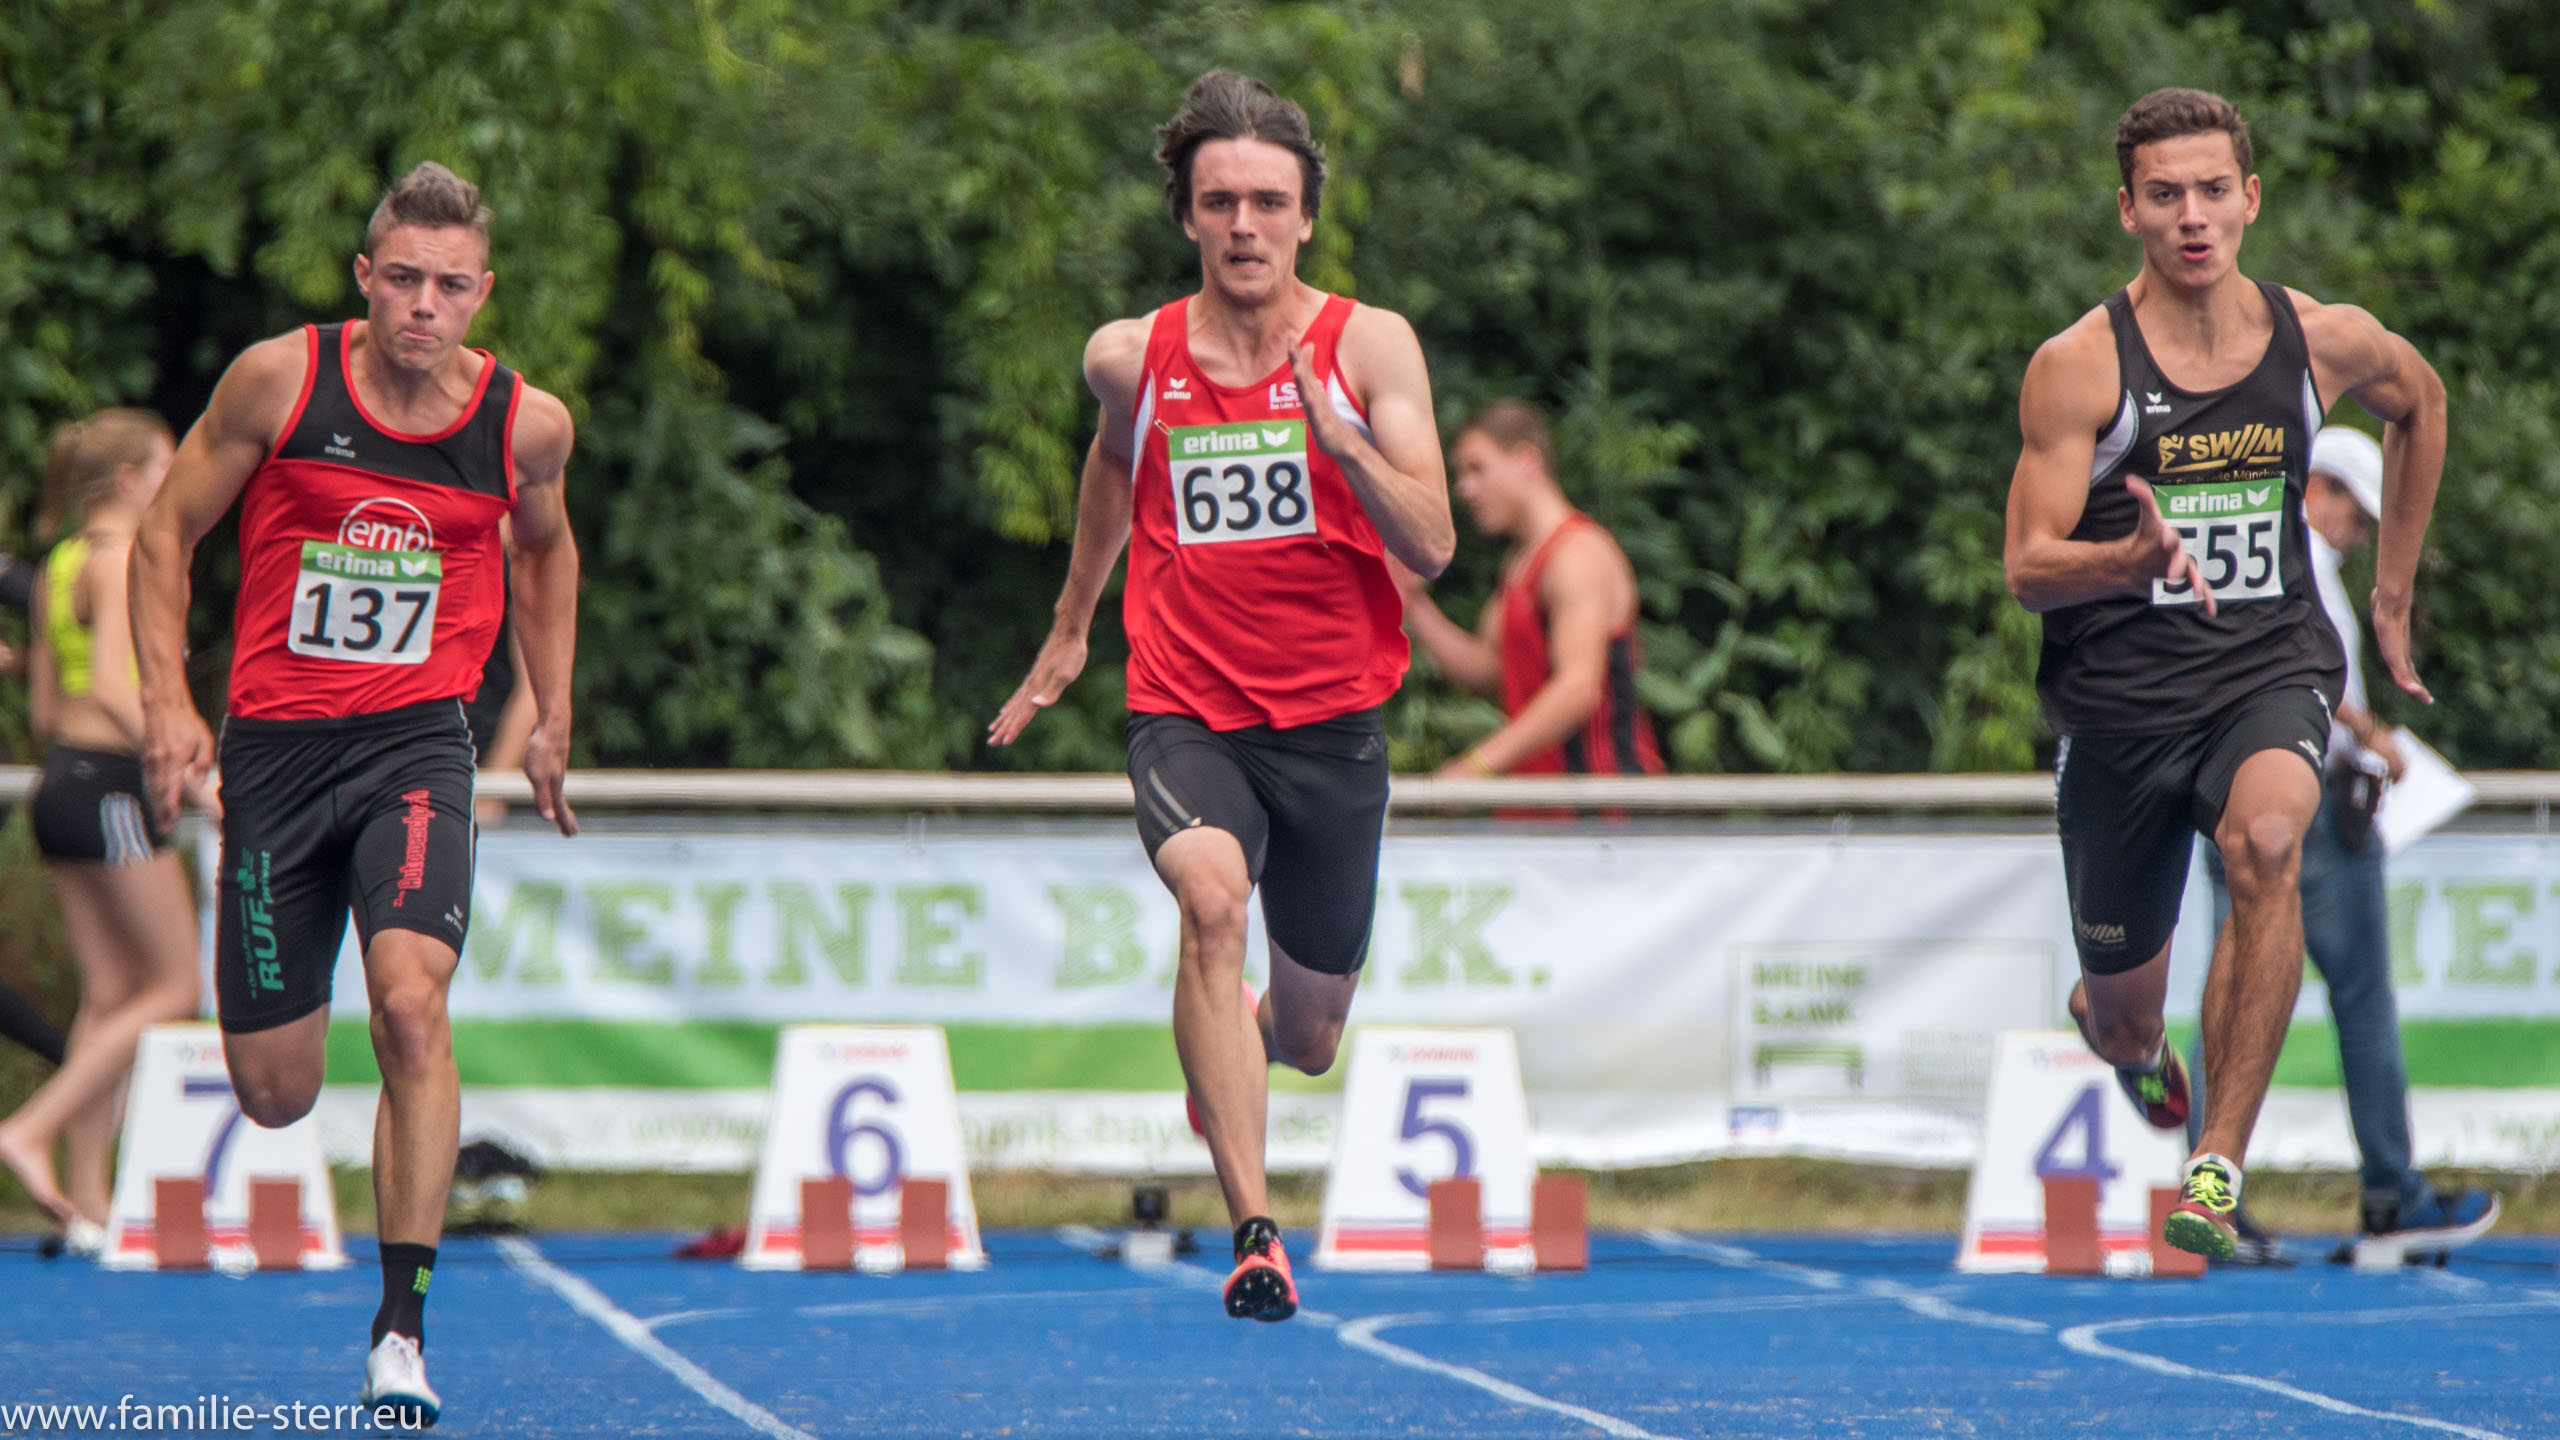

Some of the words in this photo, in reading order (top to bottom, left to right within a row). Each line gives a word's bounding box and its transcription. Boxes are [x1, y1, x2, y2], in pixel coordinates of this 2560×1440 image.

[1163, 390, 1191, 400] erima
[2146, 404, 2172, 414] erima
[324, 445, 356, 459] erima
[1183, 431, 1259, 455] erima
[1183, 460, 1308, 534] 638
[2169, 492, 2243, 514] erima
[316, 551, 396, 577] erima
[298, 581, 431, 654] 137
[250, 896, 285, 991] RUF
[458, 880, 980, 985] MEINE
[1048, 881, 1551, 987] BK.
[1754, 961, 1867, 988] MEINE
[183, 1077, 245, 1199] 7
[828, 1078, 905, 1197] 6
[1397, 1078, 1474, 1200] 5
[2036, 1083, 2118, 1206] 4
